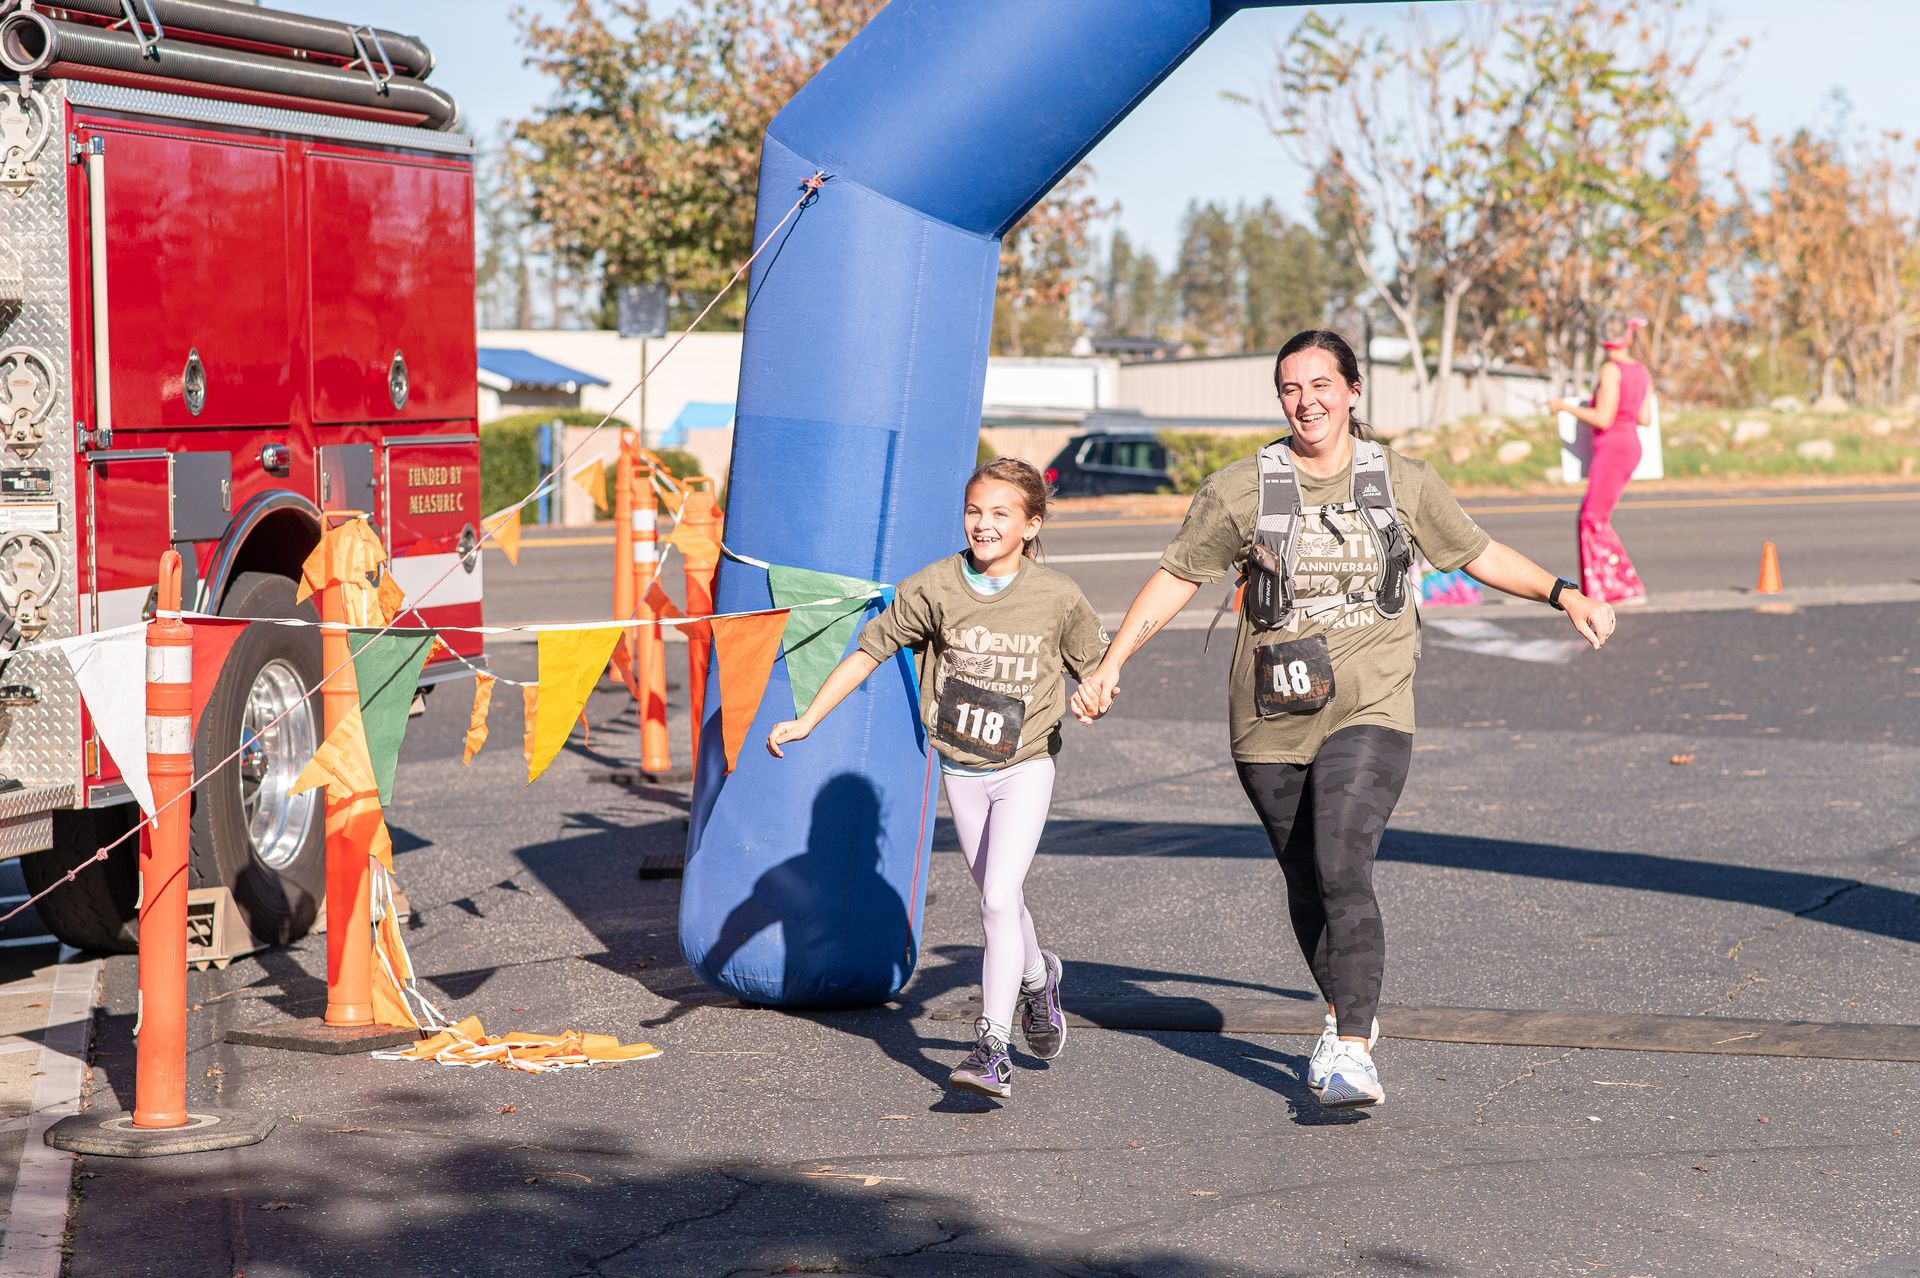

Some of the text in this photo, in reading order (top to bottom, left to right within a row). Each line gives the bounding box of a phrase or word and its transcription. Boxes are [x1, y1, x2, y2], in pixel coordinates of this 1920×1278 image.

[409, 467, 462, 487] FUNDED BY
[410, 492, 464, 514] MEASURE C
[1298, 562, 1379, 573] ANNIVERSAR
[1332, 609, 1376, 629] RUN
[1273, 660, 1311, 697] 48
[956, 702, 1005, 745] 118
